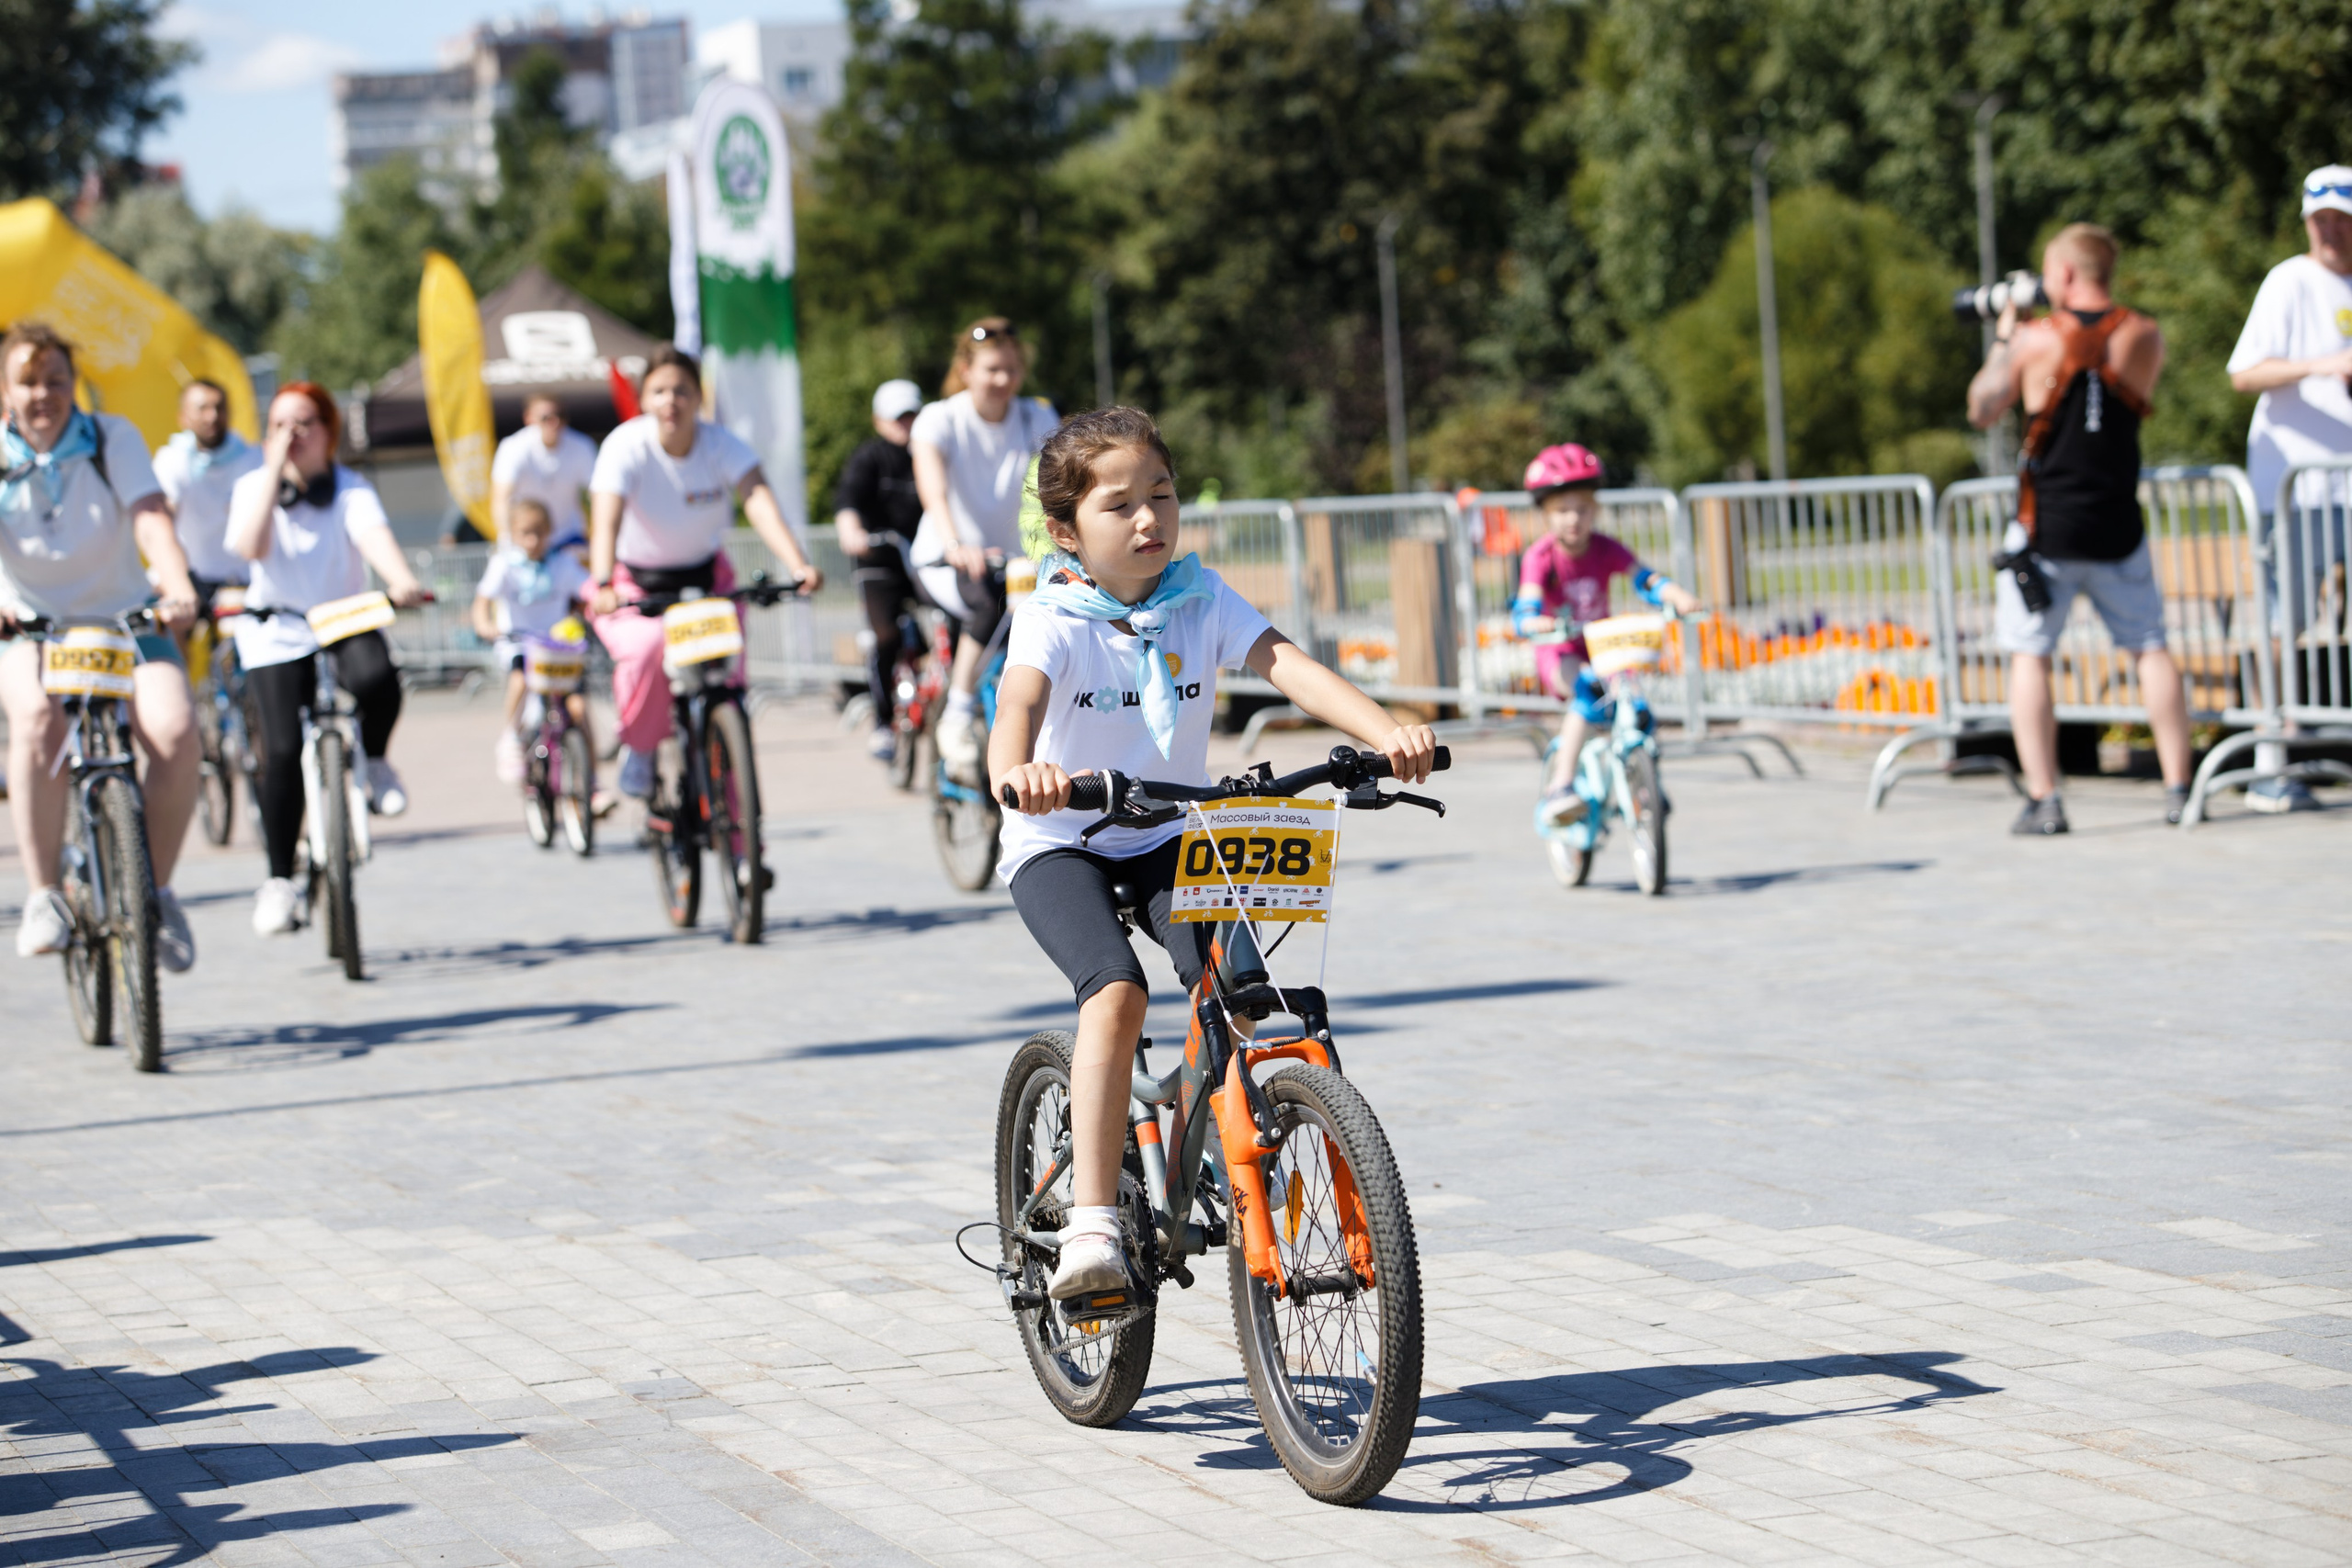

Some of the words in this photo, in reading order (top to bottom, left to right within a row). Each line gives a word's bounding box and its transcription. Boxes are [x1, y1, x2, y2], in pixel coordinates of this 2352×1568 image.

[1210, 812, 1271, 824] Массовый
[1273, 814, 1311, 826] заезд
[1185, 837, 1312, 877] 0938
